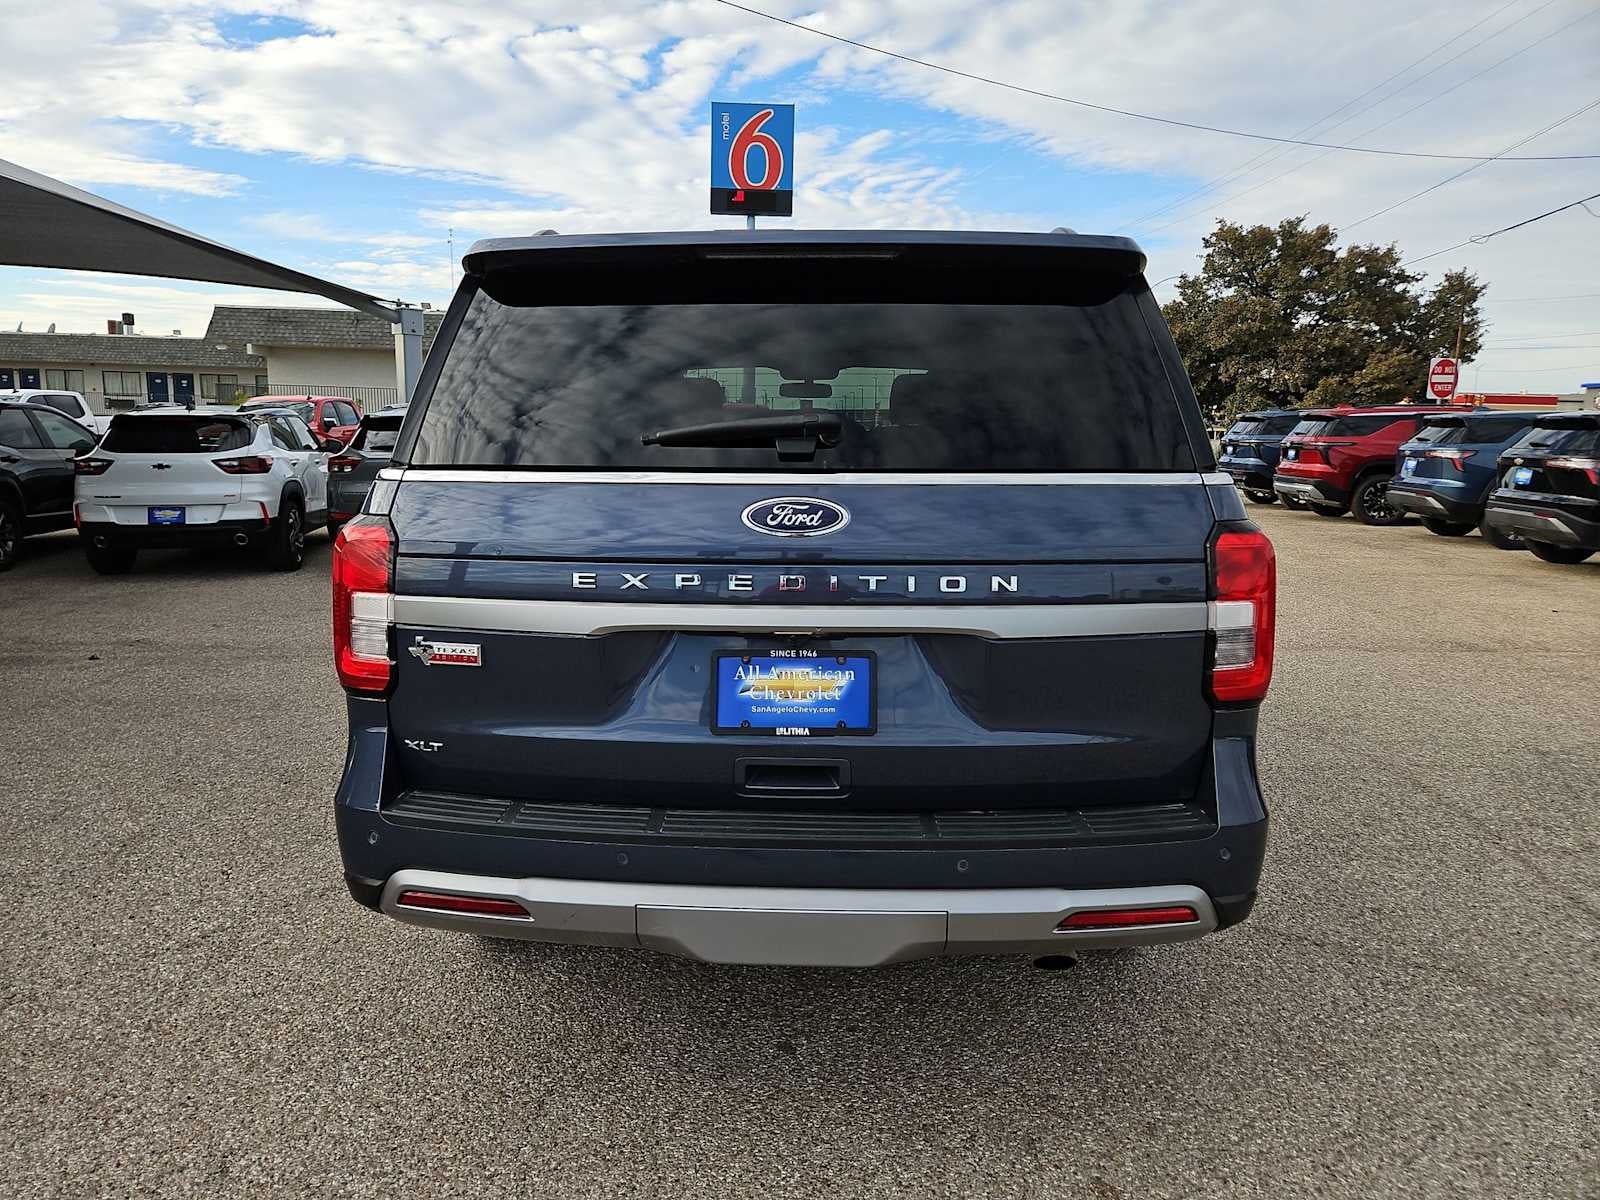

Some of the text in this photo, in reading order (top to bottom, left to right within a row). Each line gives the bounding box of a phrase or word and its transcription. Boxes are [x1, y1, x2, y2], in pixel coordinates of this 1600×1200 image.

[721, 112, 730, 140] motel
[728, 108, 784, 190] 6
[766, 503, 824, 526] Ford
[571, 571, 1019, 594] EXPEDITION
[435, 647, 476, 655] TEXAS
[435, 654, 476, 662] EDITION
[734, 665, 856, 681] All American
[750, 685, 841, 700] Chevrolet
[751, 705, 836, 714] SanAngeloChevy.com
[783, 727, 810, 735] LITHIA
[404, 739, 444, 752] XLT
